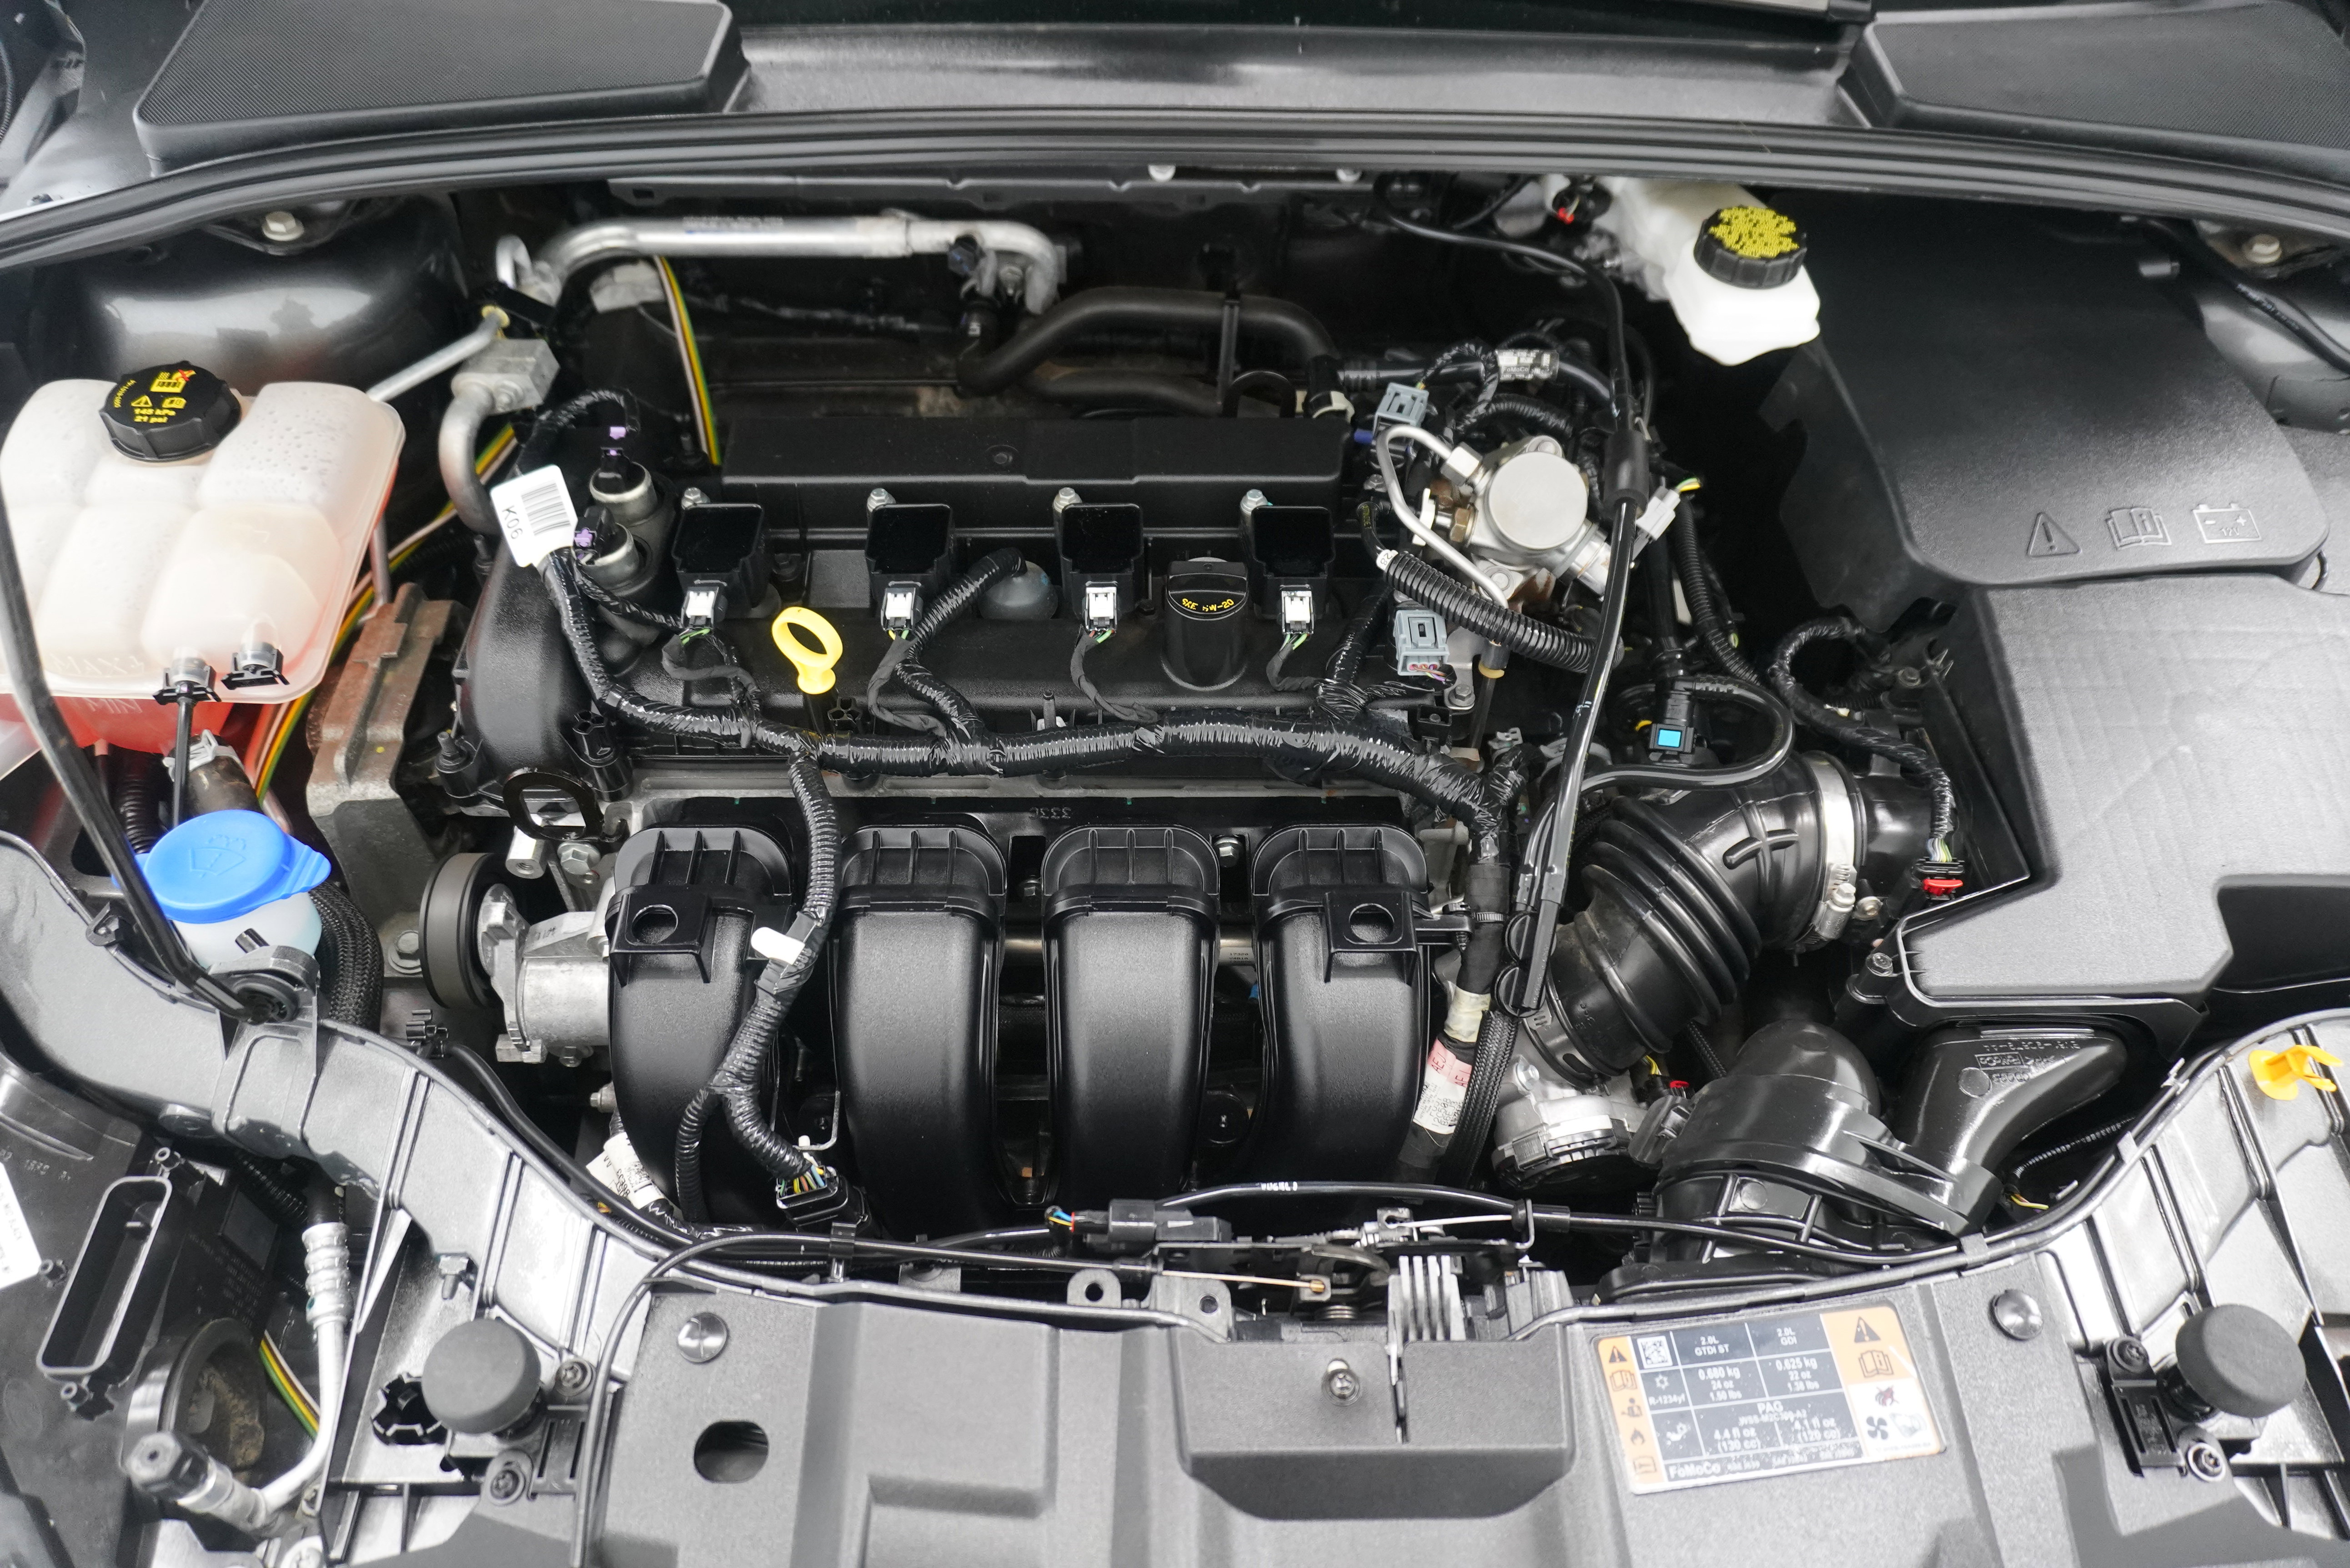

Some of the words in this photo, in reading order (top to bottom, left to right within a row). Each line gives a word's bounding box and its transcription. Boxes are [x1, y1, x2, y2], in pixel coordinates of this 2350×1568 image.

[502, 505, 523, 539] K06
[1182, 598, 1199, 610] SAE
[1202, 598, 1234, 612] 5W-20
[1431, 1052, 1447, 1074] AEJ
[1777, 1327, 1796, 1337] 2.0L
[1700, 1335, 1719, 1346] 2.0L
[1780, 1336, 1797, 1346] GDI
[1694, 1346, 1717, 1356] GTDI
[1718, 1344, 1729, 1354] ST
[1775, 1358, 1803, 1371] 0.625
[1804, 1357, 1818, 1370] kg
[1698, 1367, 1725, 1381] 0.680
[1727, 1366, 1741, 1379] kg
[1788, 1370, 1800, 1381] 22
[1801, 1370, 1812, 1379] oz
[1711, 1380, 1722, 1390] 24
[1723, 1380, 1734, 1389] oz
[1648, 1393, 1686, 1406] R-1234yf
[1757, 1400, 1784, 1414] PAG
[1822, 1417, 1836, 1428] oz
[1742, 1427, 1757, 1438] oz
[1668, 1461, 1721, 1479] FoMoCo
